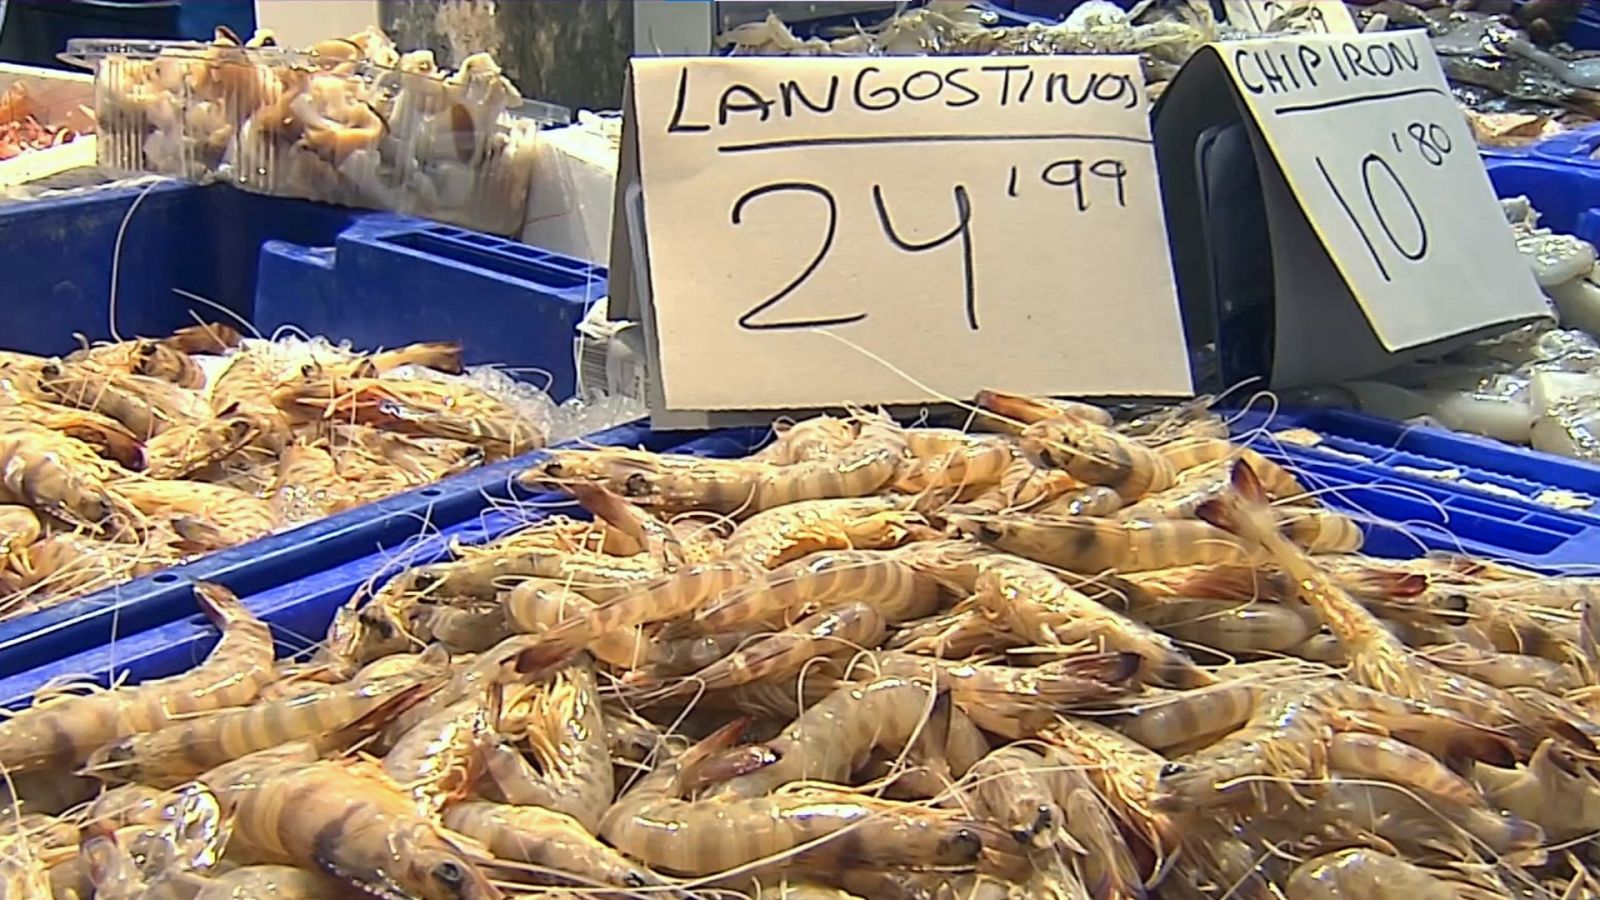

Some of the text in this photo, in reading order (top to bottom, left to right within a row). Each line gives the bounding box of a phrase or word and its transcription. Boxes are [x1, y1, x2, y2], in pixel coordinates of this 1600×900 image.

[666, 64, 1139, 134] LANGOSTINOS
[1235, 41, 1420, 97] CHIPIRON
[731, 158, 1129, 331] 24'99
[1316, 121, 1453, 283] 10'80
